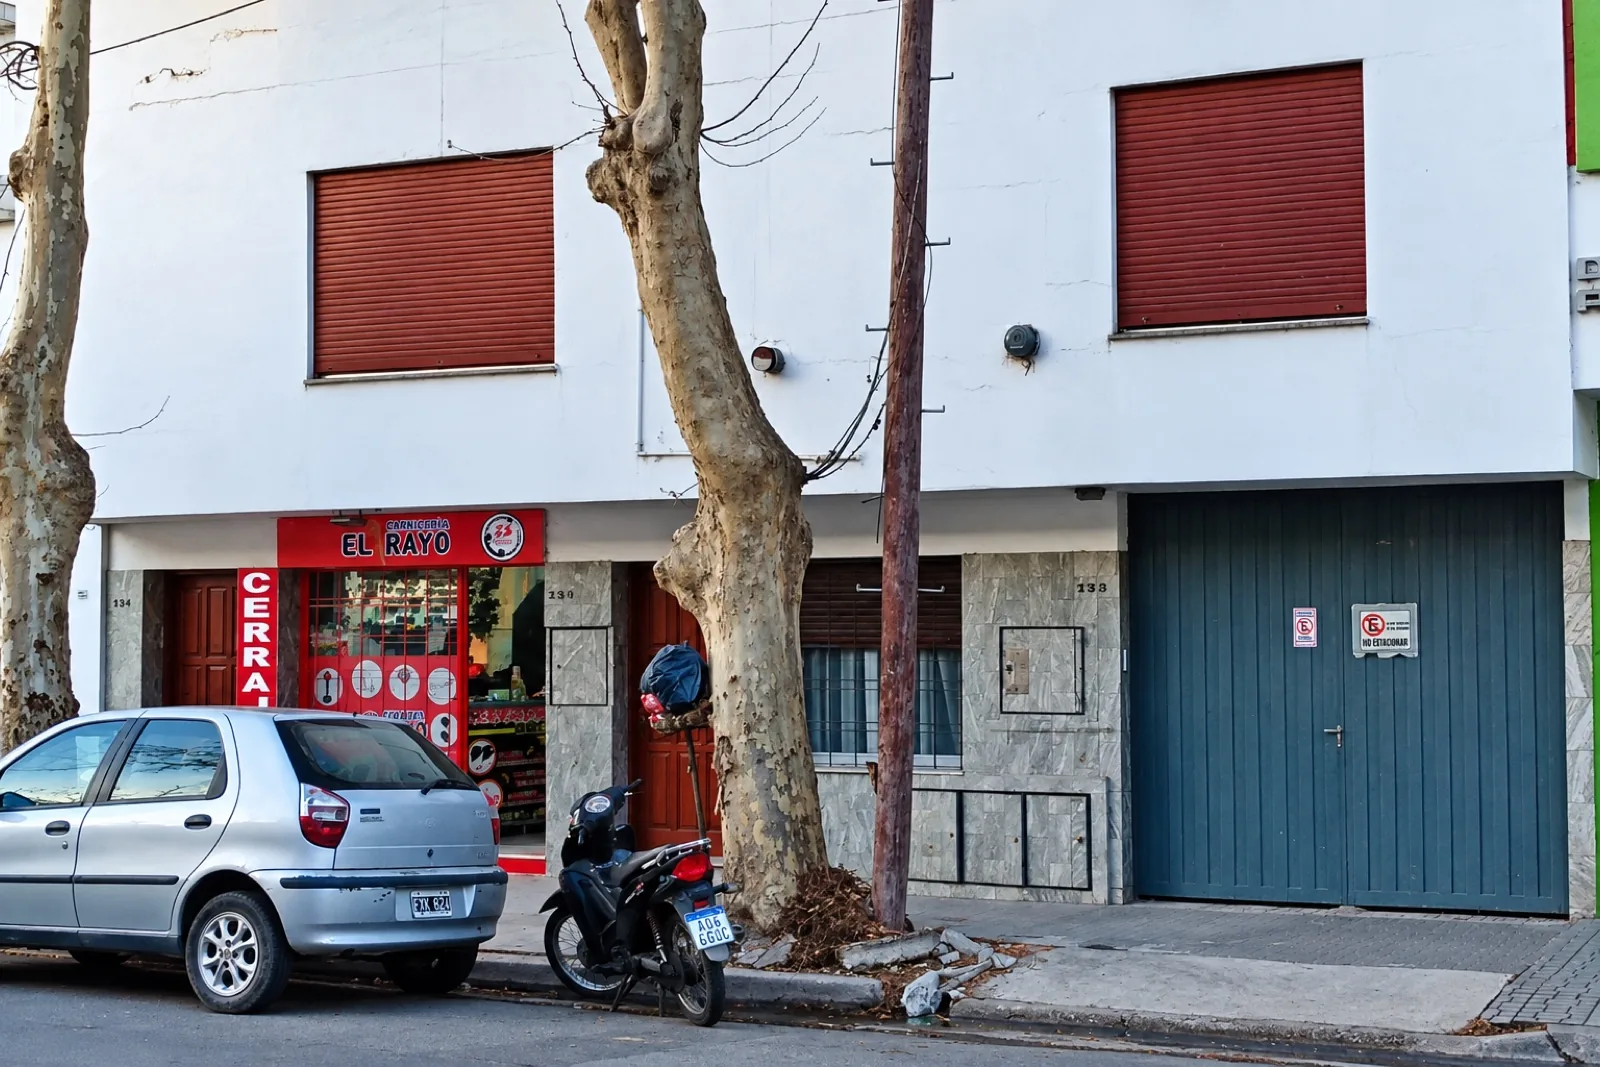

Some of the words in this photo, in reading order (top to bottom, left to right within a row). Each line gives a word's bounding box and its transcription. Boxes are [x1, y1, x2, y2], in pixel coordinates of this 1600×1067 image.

[341, 533, 373, 556] EL
[385, 531, 450, 556] RAYO
[113, 599, 131, 608] 134
[1362, 639, 1372, 647] NO
[698, 916, 721, 932] A06
